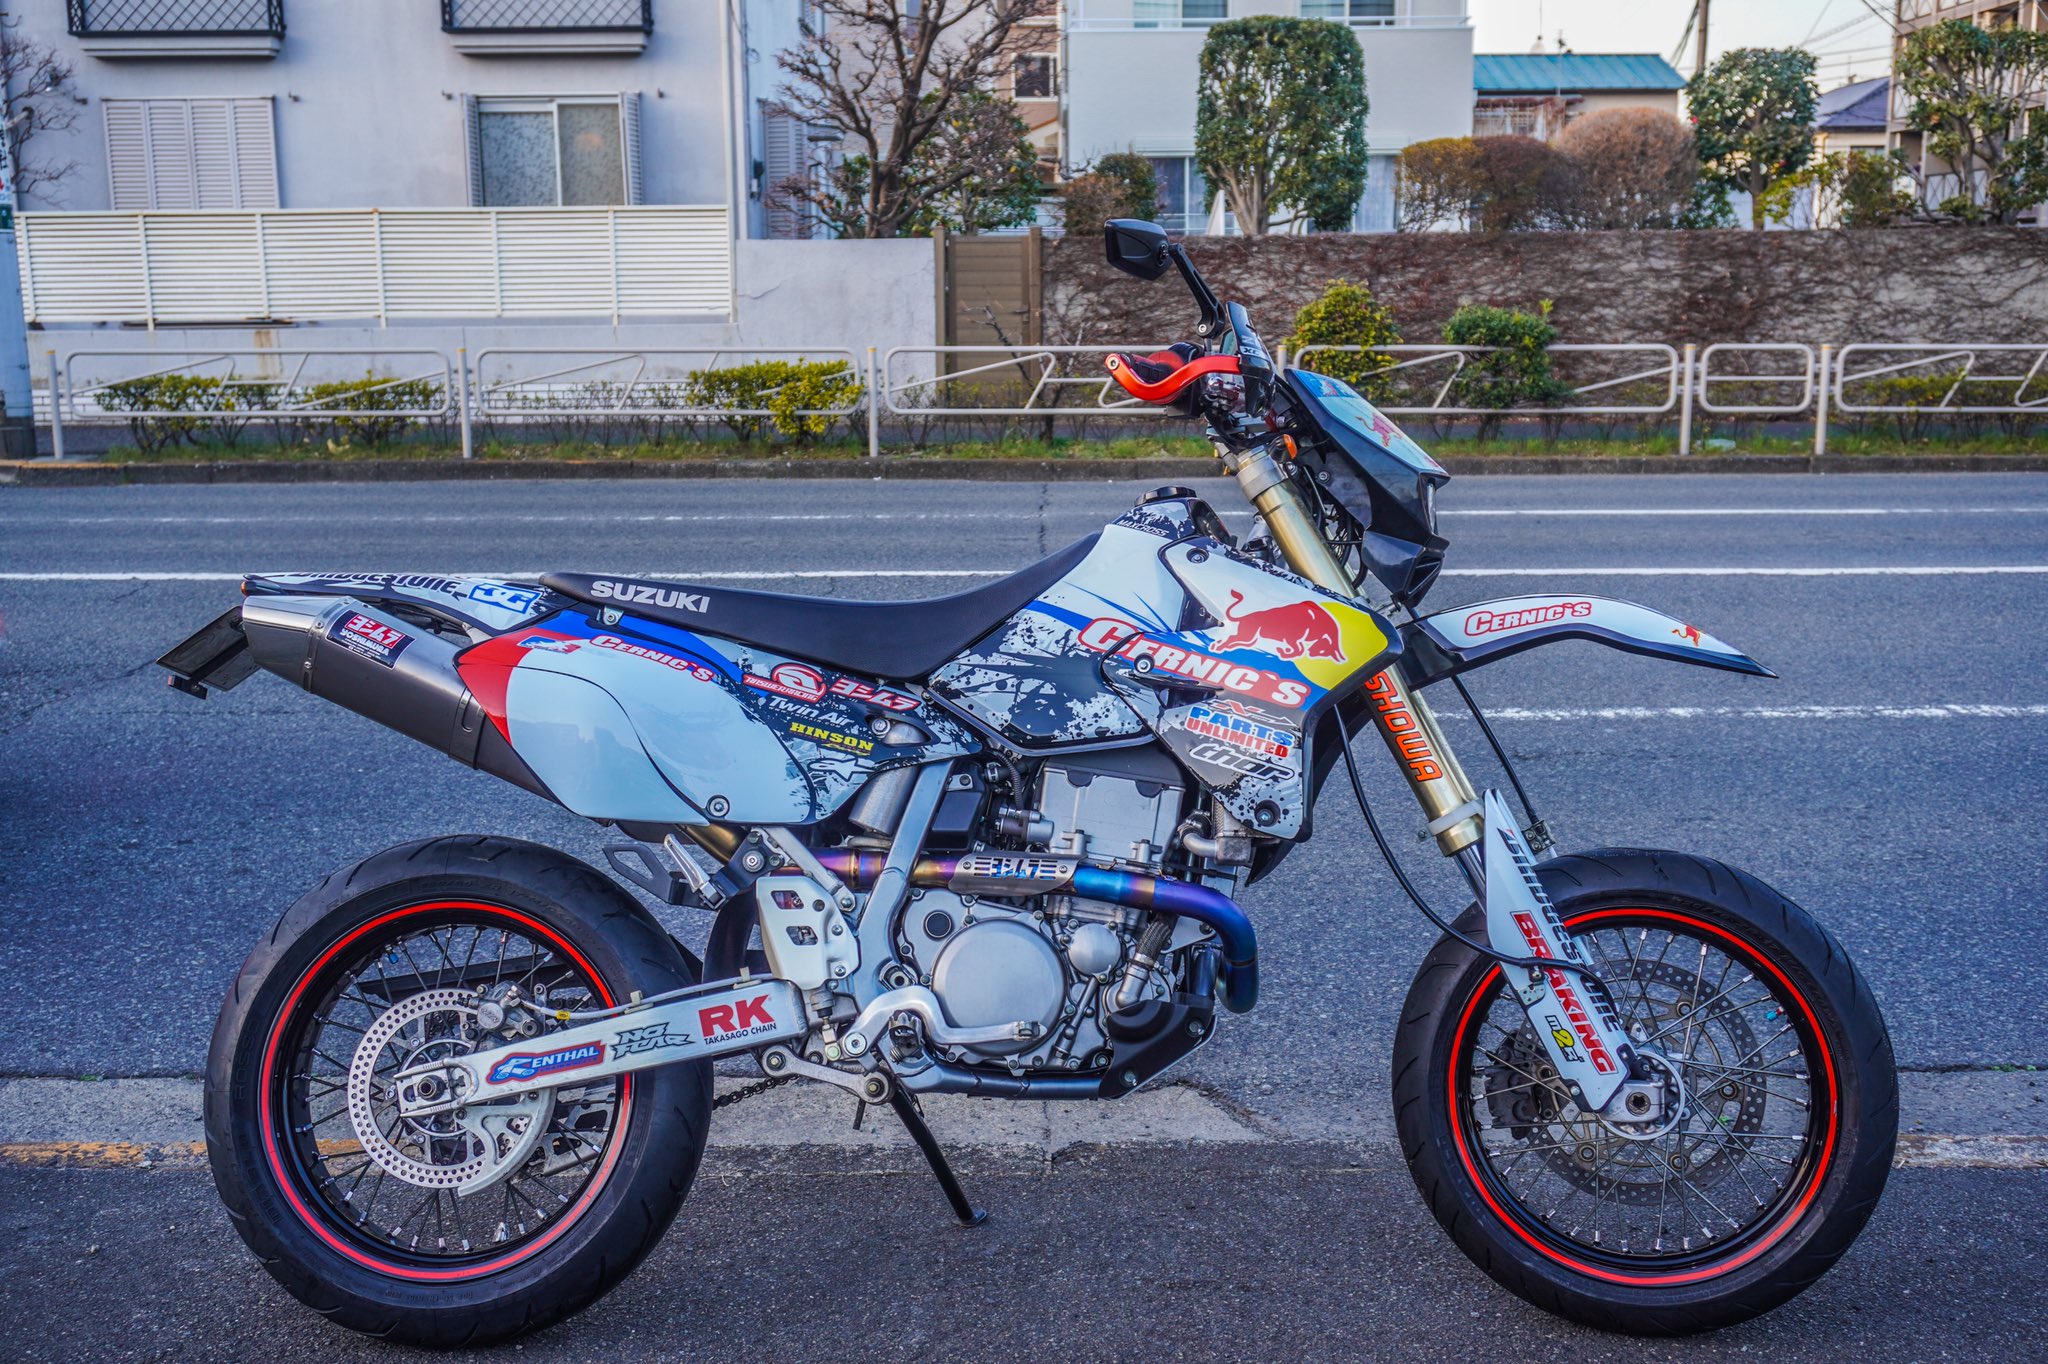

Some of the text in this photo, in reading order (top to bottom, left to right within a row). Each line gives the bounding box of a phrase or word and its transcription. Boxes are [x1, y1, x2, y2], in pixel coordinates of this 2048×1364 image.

[1118, 520, 1170, 537] MAXCROSS
[590, 580, 711, 614] SUZUKI
[339, 628, 390, 656] YOSHIMURA
[769, 695, 855, 727] Twin Air
[1188, 706, 1295, 747] PARTS
[1364, 670, 1443, 782] SHOWA
[789, 721, 874, 752] HINSON
[1186, 717, 1290, 758] UNLIMITED
[698, 994, 775, 1038] RK
[615, 1022, 671, 1044] NO
[704, 1023, 777, 1046] TAKASAGO CHAIN
